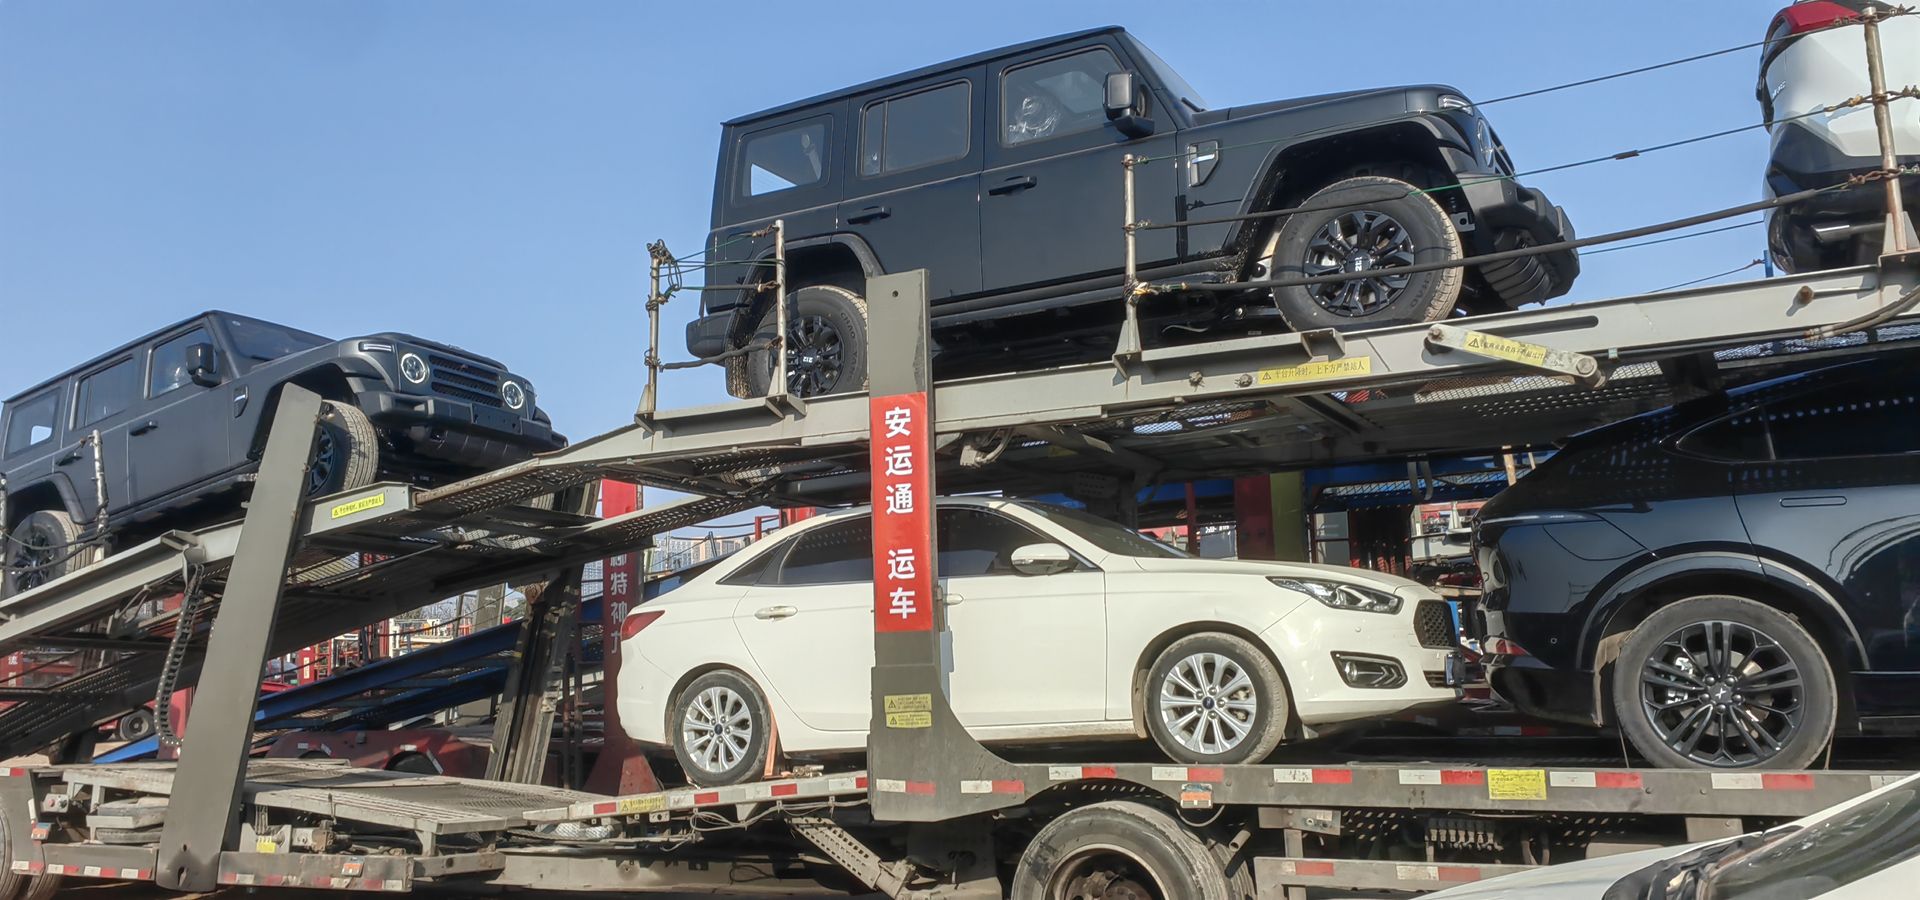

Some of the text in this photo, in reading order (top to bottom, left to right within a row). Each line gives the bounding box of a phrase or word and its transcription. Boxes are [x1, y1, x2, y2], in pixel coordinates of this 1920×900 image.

[884, 406, 917, 619] 安运通 运车
